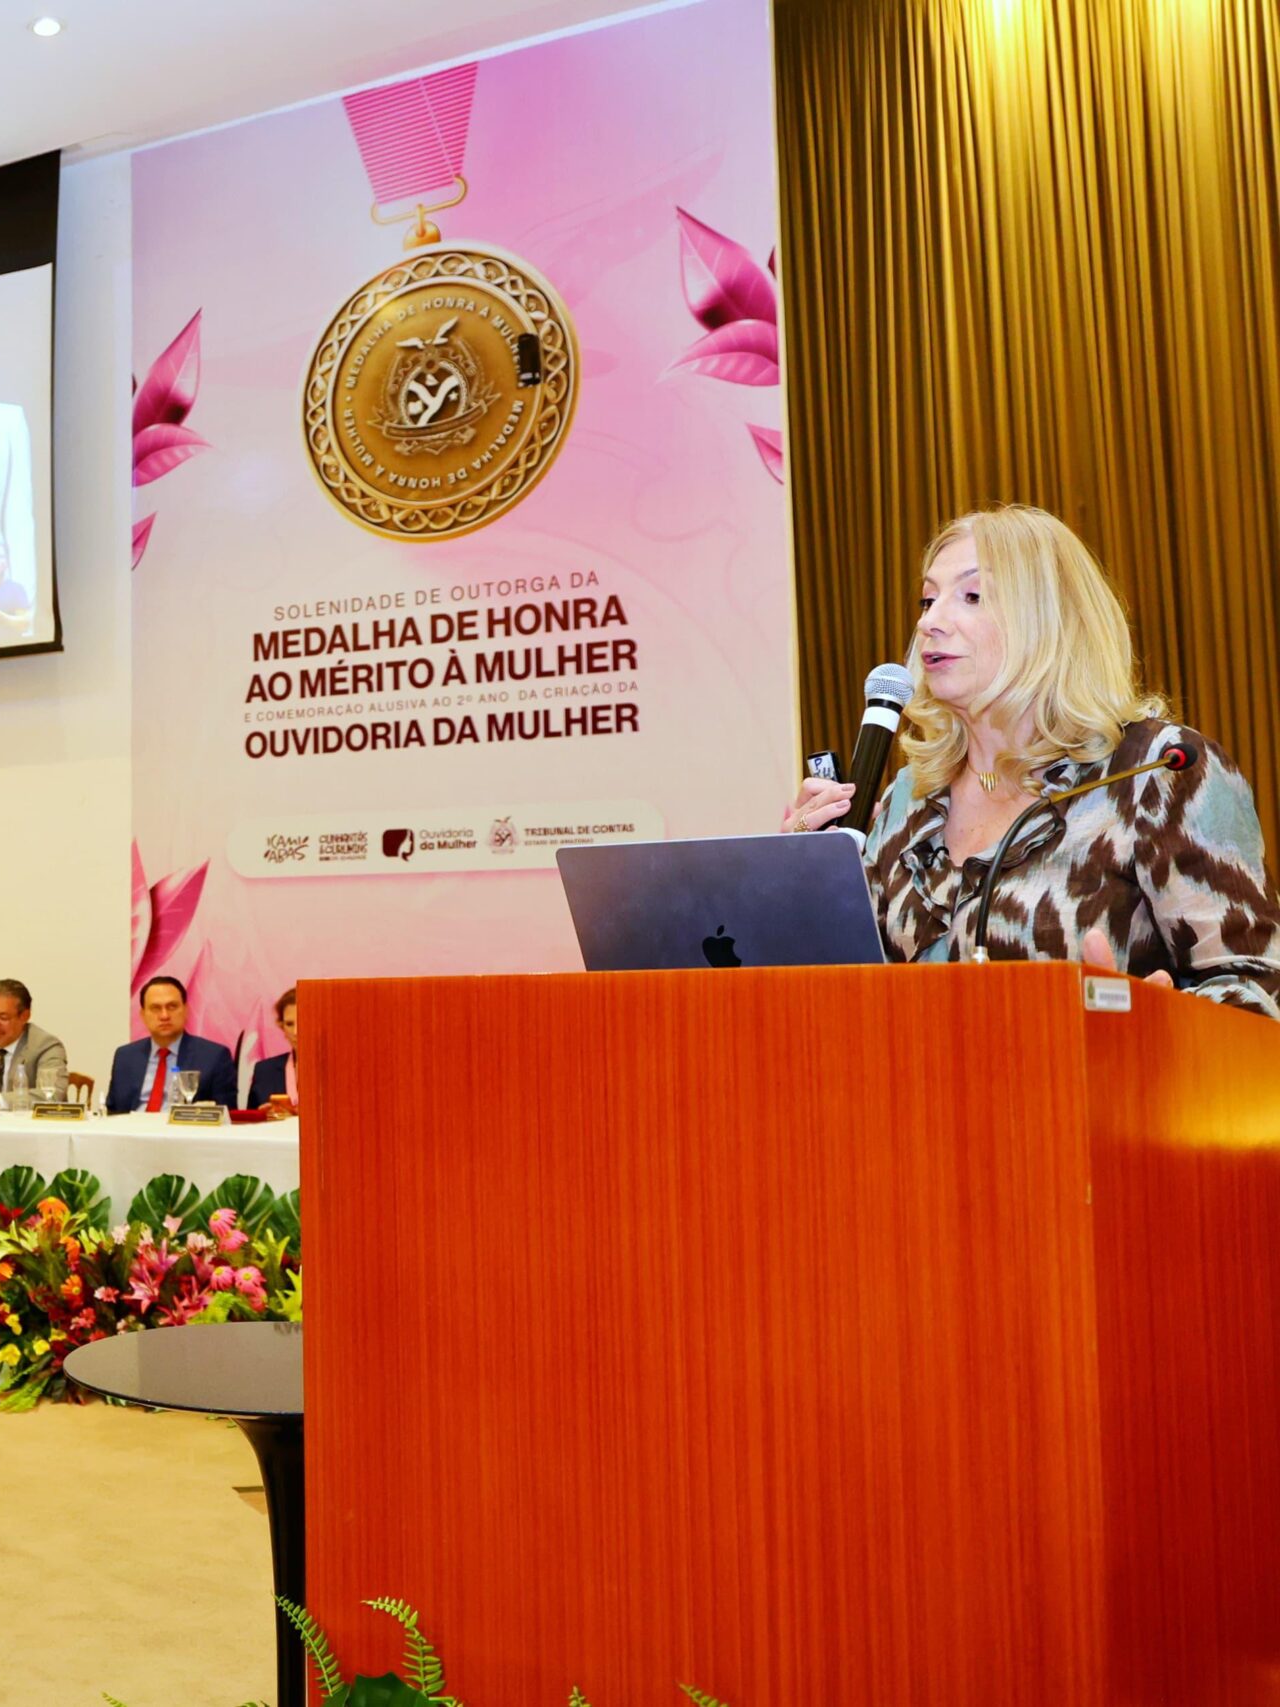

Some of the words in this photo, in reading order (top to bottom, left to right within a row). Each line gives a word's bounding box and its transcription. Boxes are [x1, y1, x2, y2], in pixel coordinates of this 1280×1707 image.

[347, 320, 393, 389] MEDALHA
[397, 304, 416, 321] DE
[421, 296, 476, 312] HONRA
[274, 592, 405, 621] SOLENIDADE
[415, 588, 441, 606] DE
[451, 575, 561, 602] OUTORGA
[570, 570, 599, 589] DA
[253, 616, 422, 662] MEDALHA
[430, 610, 479, 644] DE
[487, 595, 628, 639] HONRA
[245, 671, 292, 704] AO
[300, 659, 434, 699] MÉRITO
[442, 649, 467, 687] À
[475, 638, 638, 684] MULHER
[244, 713, 252, 723] E
[256, 704, 364, 722] COMEMORAÇÃO
[369, 699, 427, 713] ALUSIVA
[432, 696, 452, 708] AO
[478, 691, 509, 704] ANO
[518, 689, 538, 701] DA
[543, 682, 612, 700] CRIAÇÃO
[618, 681, 638, 693] DA
[245, 719, 426, 759] OUVIDORIA
[433, 715, 480, 746] DA
[487, 703, 639, 743] MULHER
[420, 828, 474, 841] Ouvidoria
[420, 841, 435, 851] da
[437, 839, 478, 850] Mulher
[524, 826, 575, 837] TRIBUNAL
[577, 826, 590, 835] DE
[592, 824, 636, 834] CONTAS
